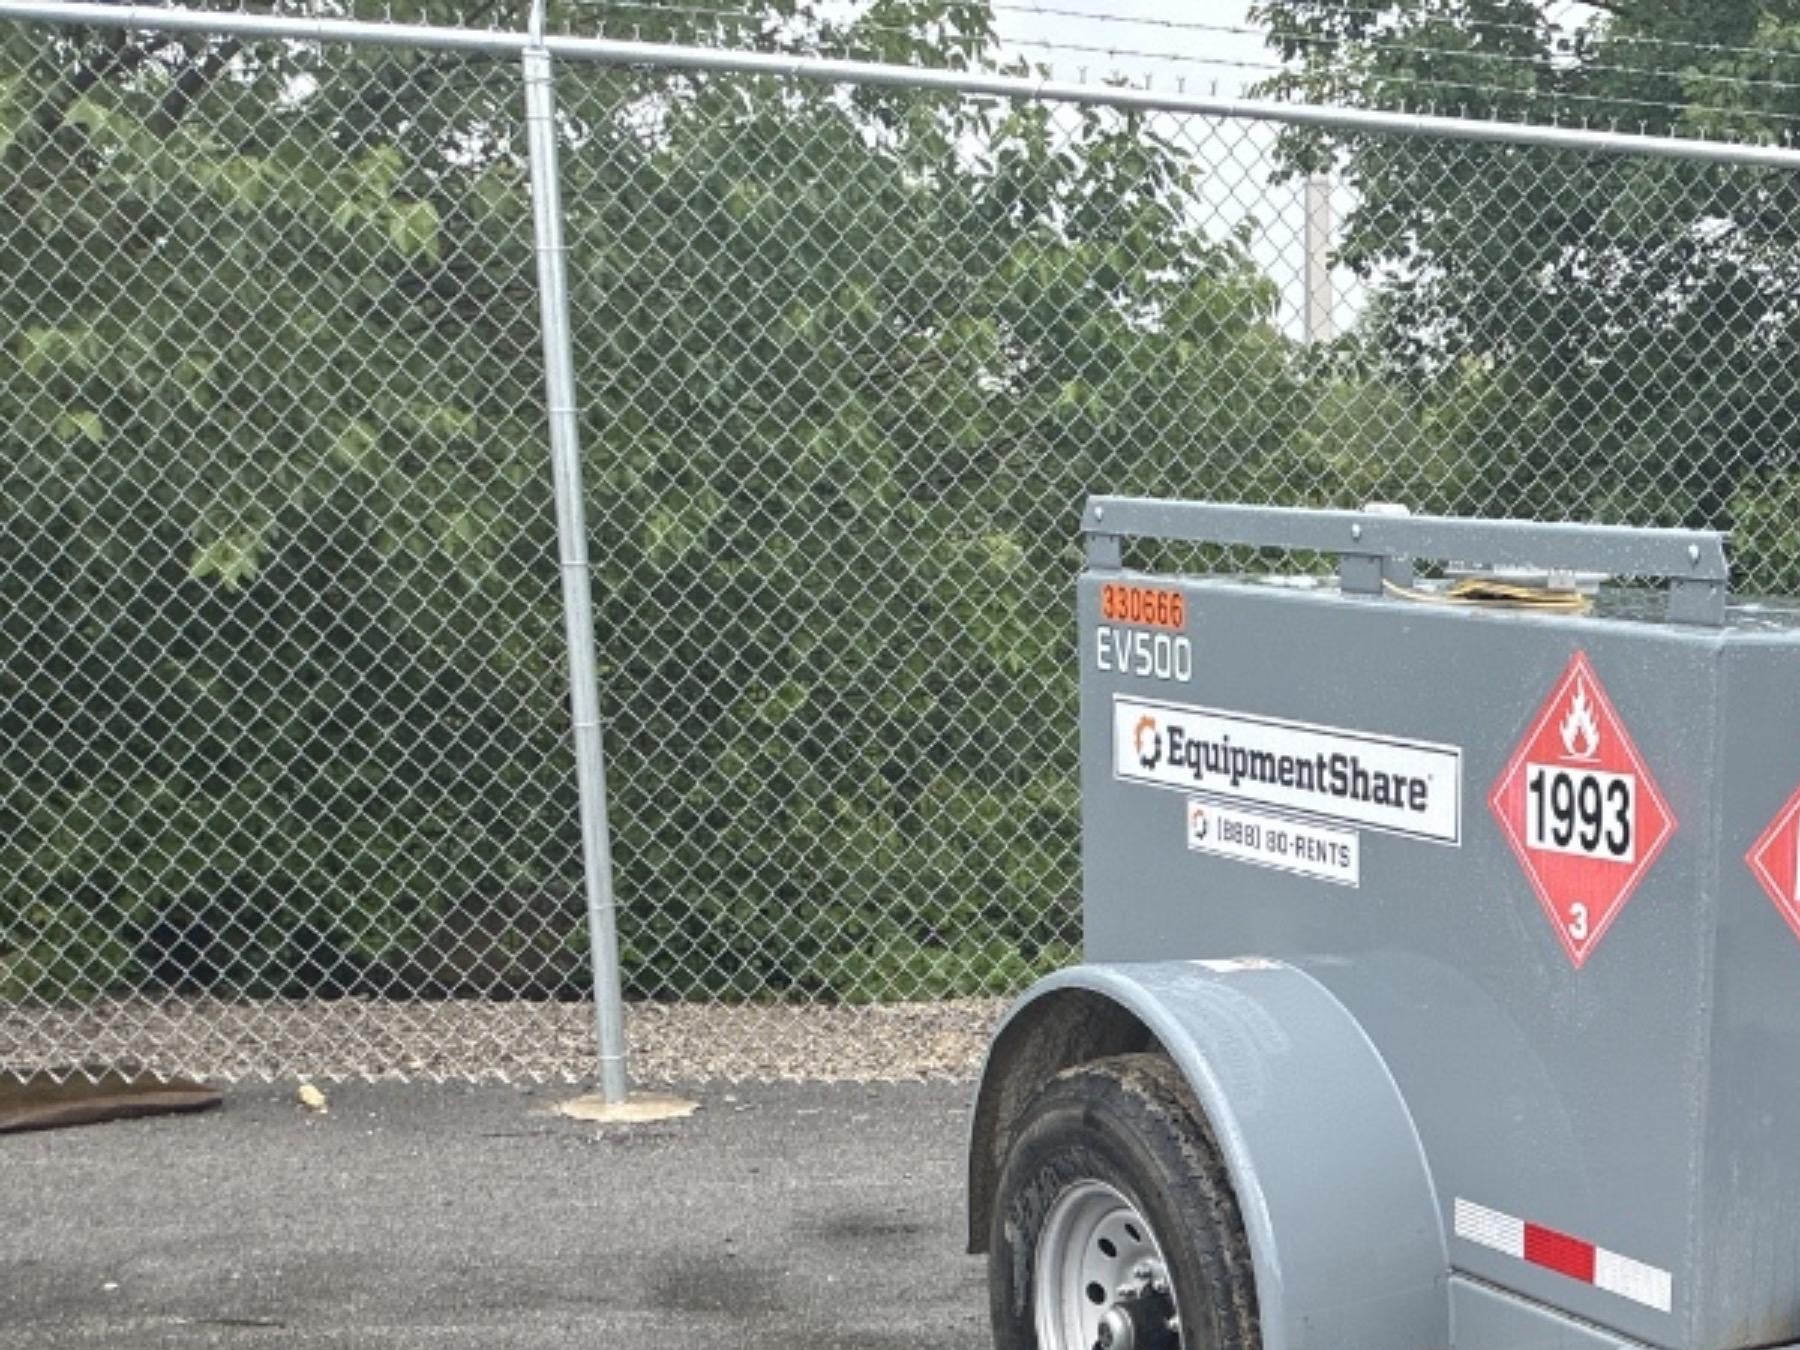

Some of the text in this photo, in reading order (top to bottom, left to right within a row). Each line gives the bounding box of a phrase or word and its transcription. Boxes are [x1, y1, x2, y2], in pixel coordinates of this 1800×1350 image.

[1103, 585, 1183, 628] 330666
[1096, 625, 1192, 682] EV500
[1166, 724, 1429, 812] EquipmentShare
[1529, 768, 1631, 857] 1993
[1265, 829, 1351, 868] 80-RENTS
[1568, 902, 1588, 940] 3
